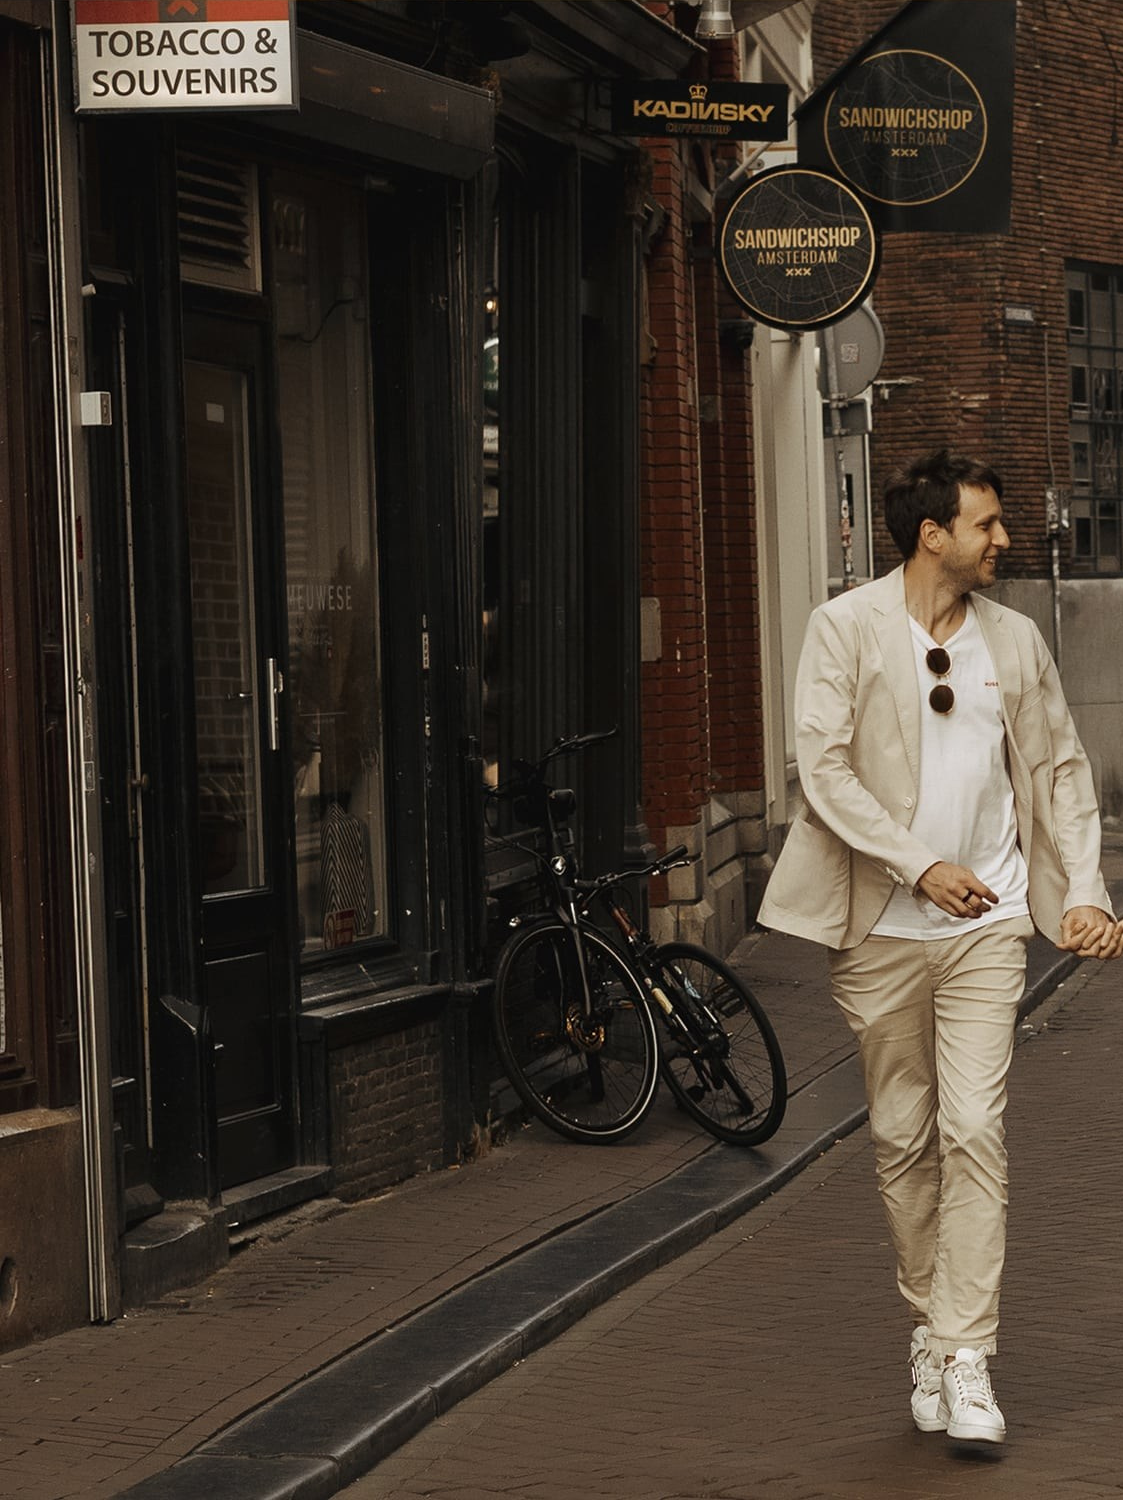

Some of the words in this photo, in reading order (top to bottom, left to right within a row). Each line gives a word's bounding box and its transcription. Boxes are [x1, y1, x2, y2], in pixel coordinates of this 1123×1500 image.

[88, 28, 246, 58] TOBACCO
[254, 27, 278, 54] &
[92, 66, 278, 97] SOUVENIRS
[839, 107, 973, 130] SANDWICHSHOP
[863, 130, 947, 146] AMSTERDAM
[734, 226, 861, 249] SANDWICHSHOP
[757, 250, 838, 265] AMSTERDAM
